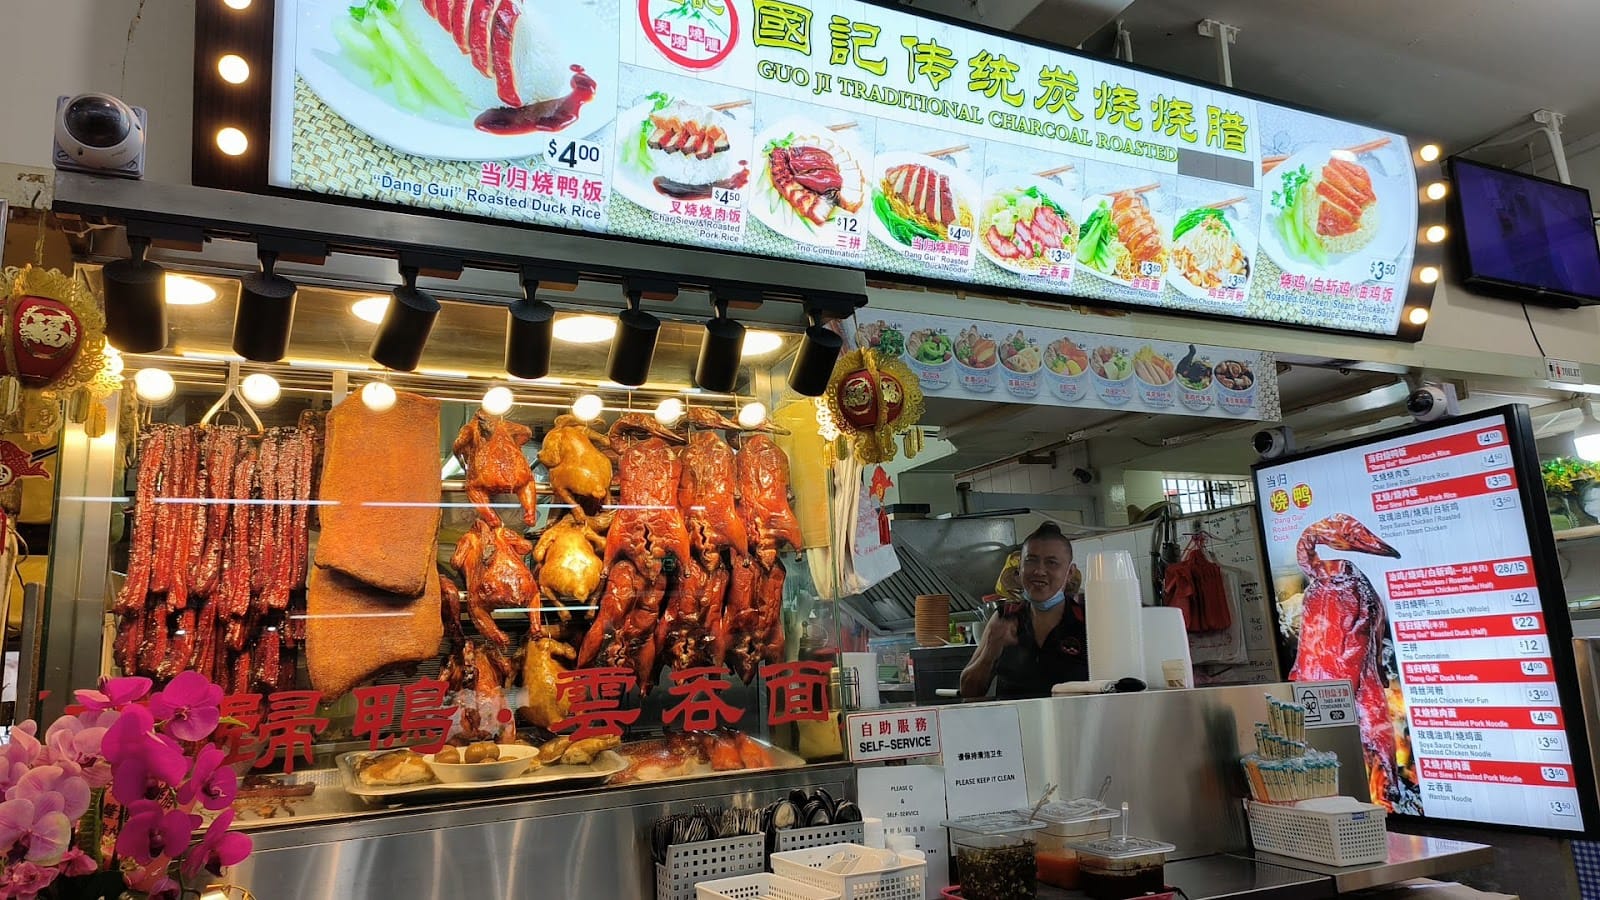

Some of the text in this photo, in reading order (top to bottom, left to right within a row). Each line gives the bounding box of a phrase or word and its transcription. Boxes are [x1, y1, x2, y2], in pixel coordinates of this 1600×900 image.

[757, 59, 1178, 163] GUO JI TRADITIONAL CHARCOAL ROASTED
[481, 162, 603, 202] 当归烧鸭饭
[373, 174, 601, 220] “Dang Gui” Roasted Duck Rice
[669, 201, 741, 224] 叉烧烧肉饭
[653, 213, 672, 223] Char
[675, 215, 695, 227] Siew
[706, 219, 741, 233] Roasted
[837, 217, 858, 232] $12
[700, 230, 740, 243] Pork Rice
[836, 235, 861, 250] 三拼
[797, 243, 860, 259] Trio Combination
[912, 236, 970, 258] 当归烧鸭面
[925, 262, 969, 274] Duck Noodle
[941, 255, 969, 267] Roasted
[1039, 265, 1071, 279] 云吞面
[1115, 287, 1137, 297] Chicken
[1266, 291, 1385, 314] Roasted Chicken Steam Chicken
[1301, 306, 1387, 325] Soy Sauce Chicken Rice
[1561, 367, 1580, 377] TOILET
[1422, 452, 1436, 460] Duck
[1437, 449, 1451, 457] Rice
[1266, 473, 1287, 488] 当归
[1271, 485, 1312, 513] 烧鸭
[1412, 513, 1461, 526] Chicken Roasted
[1272, 524, 1298, 533] Roasted
[1273, 534, 1290, 542] Duck
[1511, 592, 1529, 603] $42
[1426, 608, 1449, 616] Roasted
[1515, 617, 1534, 628] $22
[1402, 643, 1418, 652] 三拼
[1520, 640, 1538, 651] $12
[861, 717, 928, 738] 自助服務
[859, 735, 931, 753] SELF-SERVICE
[1445, 749, 1469, 757] Chicken
[1470, 750, 1492, 758] Noodle
[955, 777, 976, 787] PLEASE
[977, 776, 990, 784] KEEP
[997, 773, 1015, 783] CLEAN
[1427, 782, 1452, 792] 云吞面
